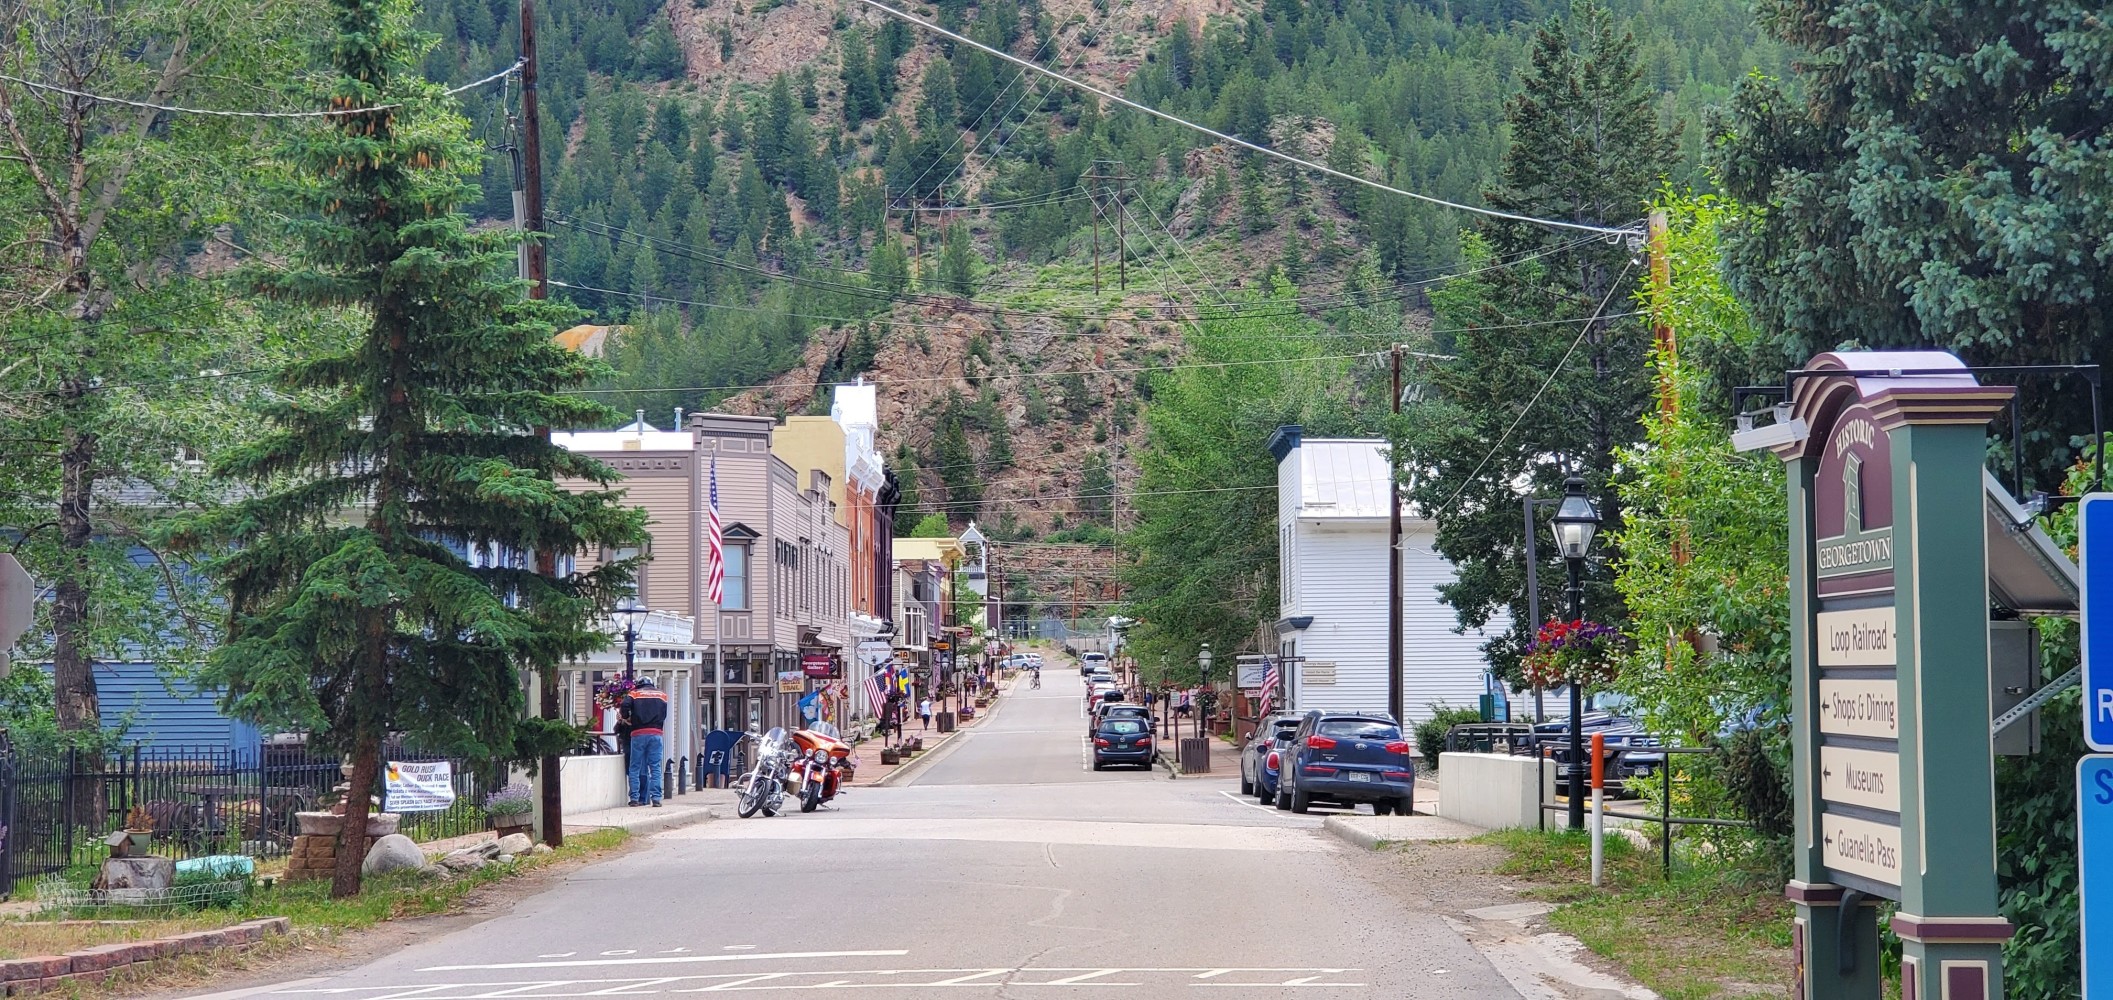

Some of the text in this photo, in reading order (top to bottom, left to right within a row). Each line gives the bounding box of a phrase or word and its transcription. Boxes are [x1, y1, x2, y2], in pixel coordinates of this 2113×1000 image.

[1835, 418, 1875, 460] HISTORIC
[1819, 537, 1891, 570] GEORGETOWN
[1830, 620, 1887, 658] Loop Railroad
[1832, 691, 1895, 730] Shops & Dining
[401, 765, 436, 774] GOLD RUSH
[416, 773, 450, 782] DUCK RACE
[1845, 762, 1884, 795] Museums
[1837, 829, 1896, 870] Guanella Pass
